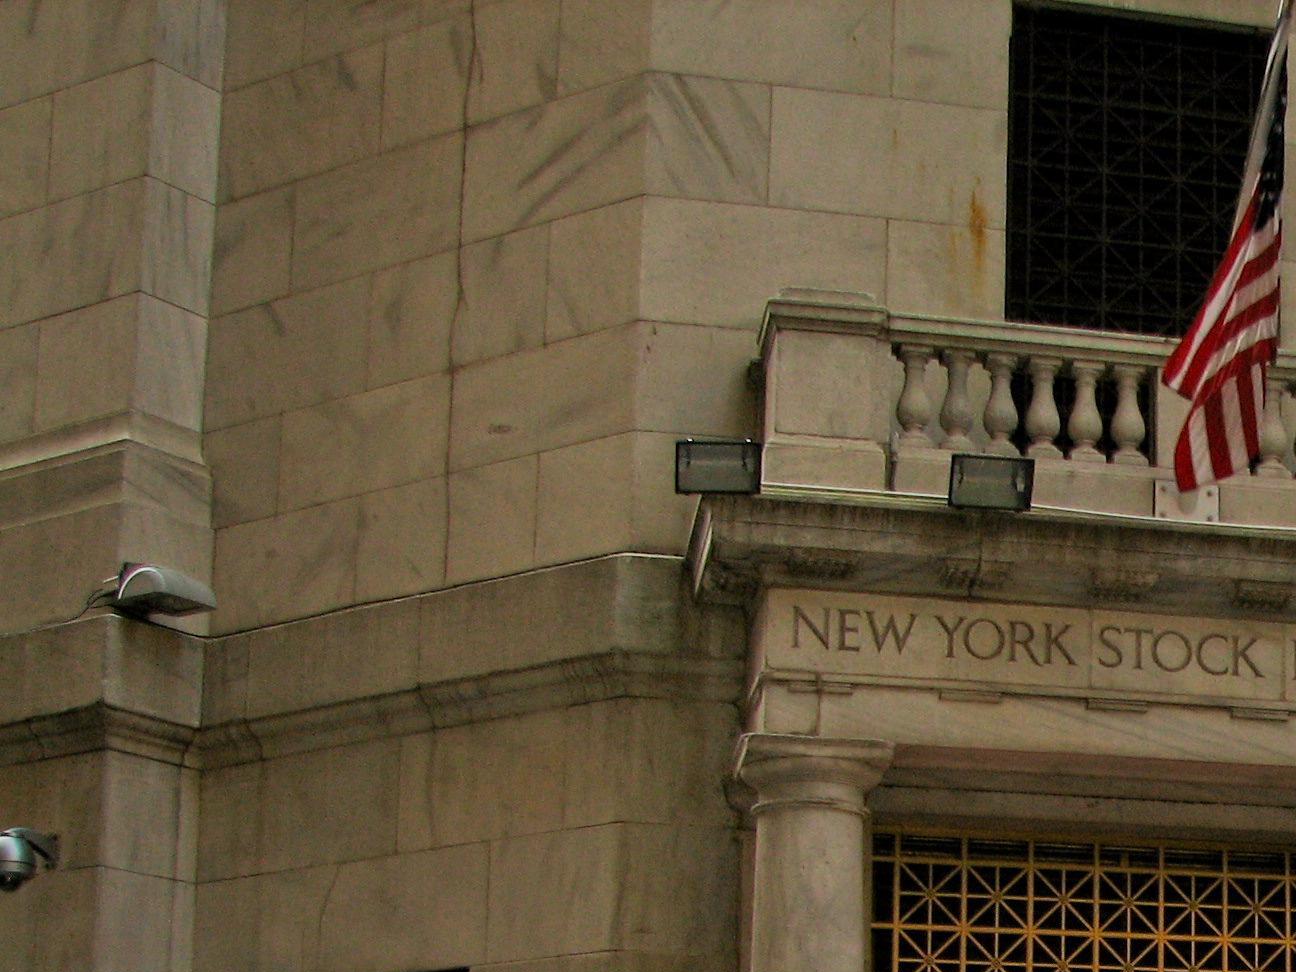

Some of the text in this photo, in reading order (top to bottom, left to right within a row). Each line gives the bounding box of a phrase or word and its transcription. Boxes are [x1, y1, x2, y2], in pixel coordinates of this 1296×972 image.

[791, 606, 917, 655] NEW
[934, 614, 1077, 667] YORK
[1098, 625, 1266, 678] STOCK
